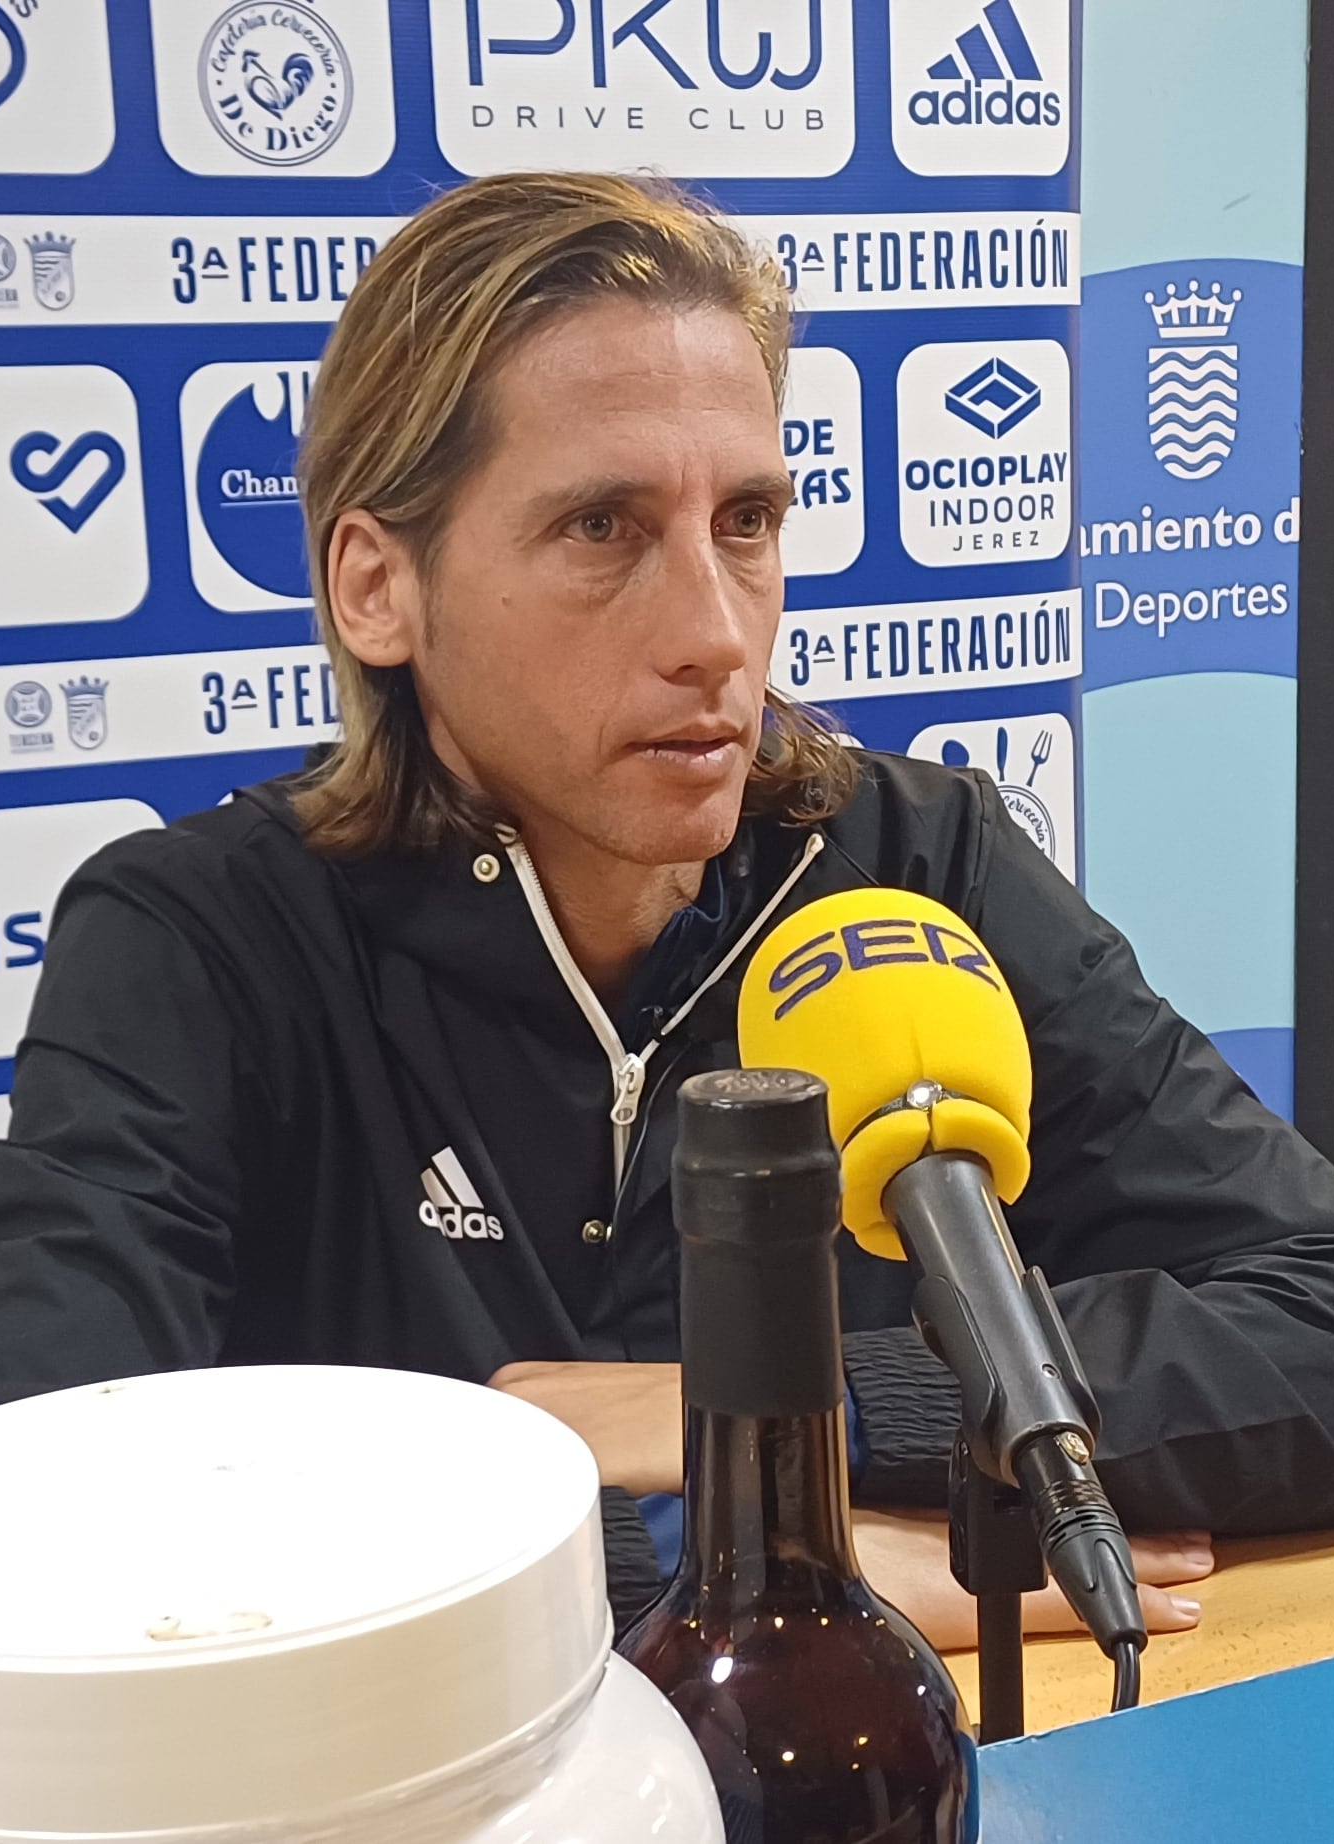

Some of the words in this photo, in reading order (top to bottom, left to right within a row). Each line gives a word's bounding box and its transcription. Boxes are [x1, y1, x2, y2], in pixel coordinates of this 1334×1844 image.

[218, 93, 254, 138] De
[265, 95, 337, 151] Diego
[471, 105, 645, 130] DRIVE
[688, 107, 825, 132] CLUB
[907, 80, 1061, 127] adidas
[833, 218, 1068, 293] FEDERACIÓN
[783, 417, 835, 457] DE
[905, 452, 1068, 491] OCIOPLAY
[929, 493, 1055, 527] INDOOR
[952, 531, 1040, 552] JEREZ
[1094, 581, 1289, 639] Deportes
[843, 599, 1070, 682] FEDERACIÓN
[768, 919, 1001, 1021] SER
